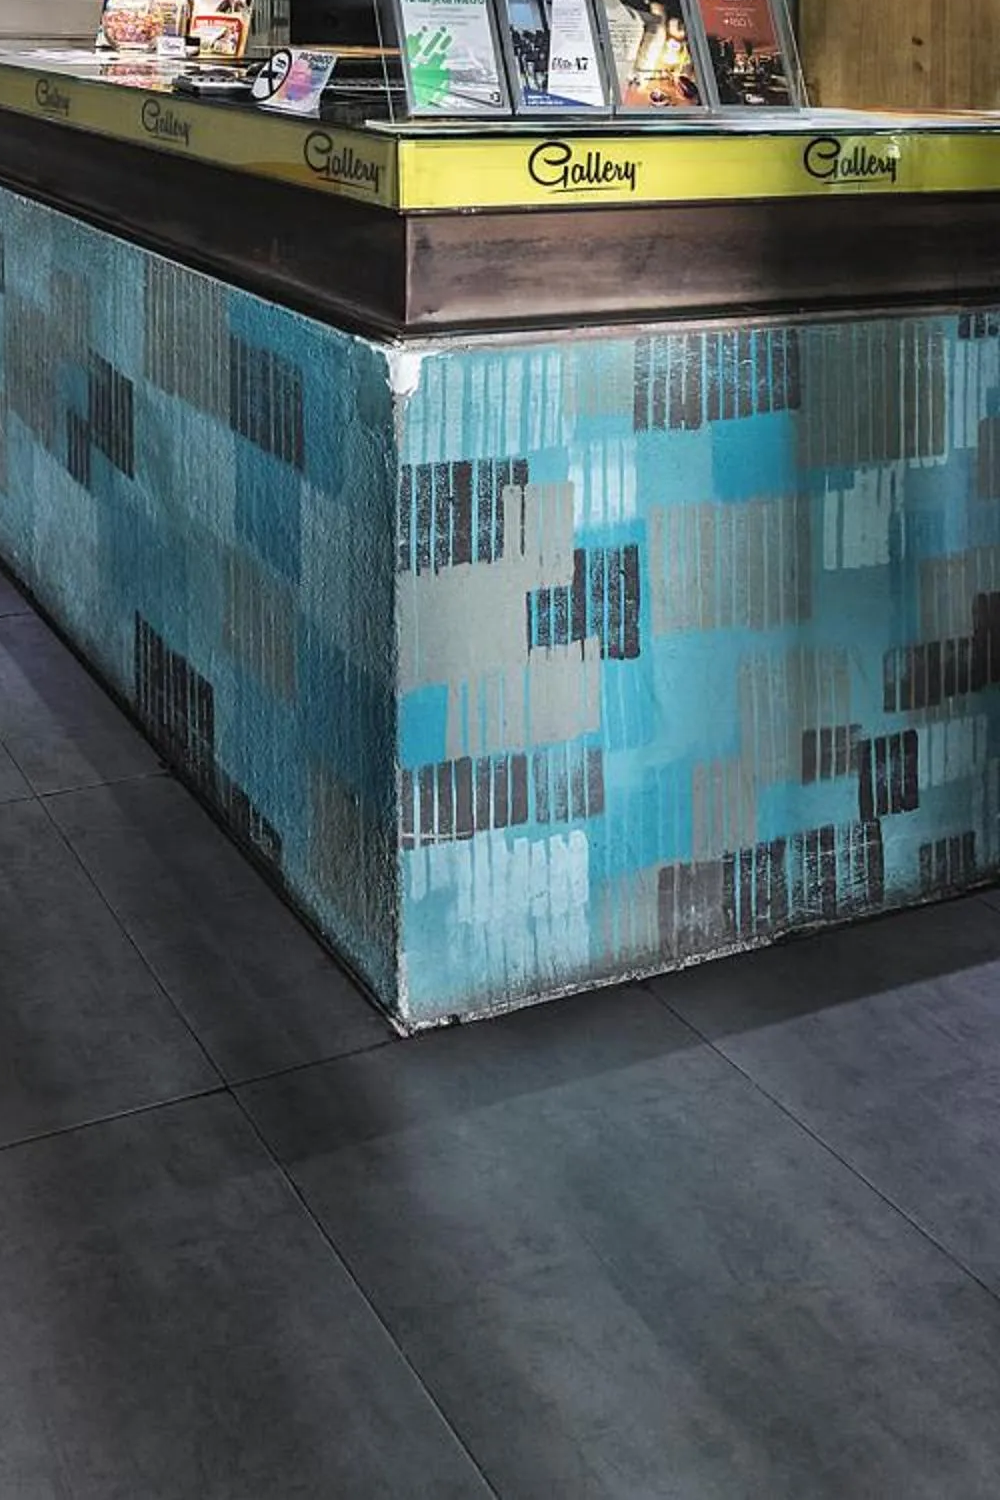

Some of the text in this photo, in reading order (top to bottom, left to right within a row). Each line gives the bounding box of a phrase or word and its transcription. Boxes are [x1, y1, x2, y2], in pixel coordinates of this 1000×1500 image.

[141, 99, 192, 146] Gallery
[304, 130, 381, 193] Gallery
[528, 141, 637, 190] Gallery
[804, 137, 898, 184] Gallery
